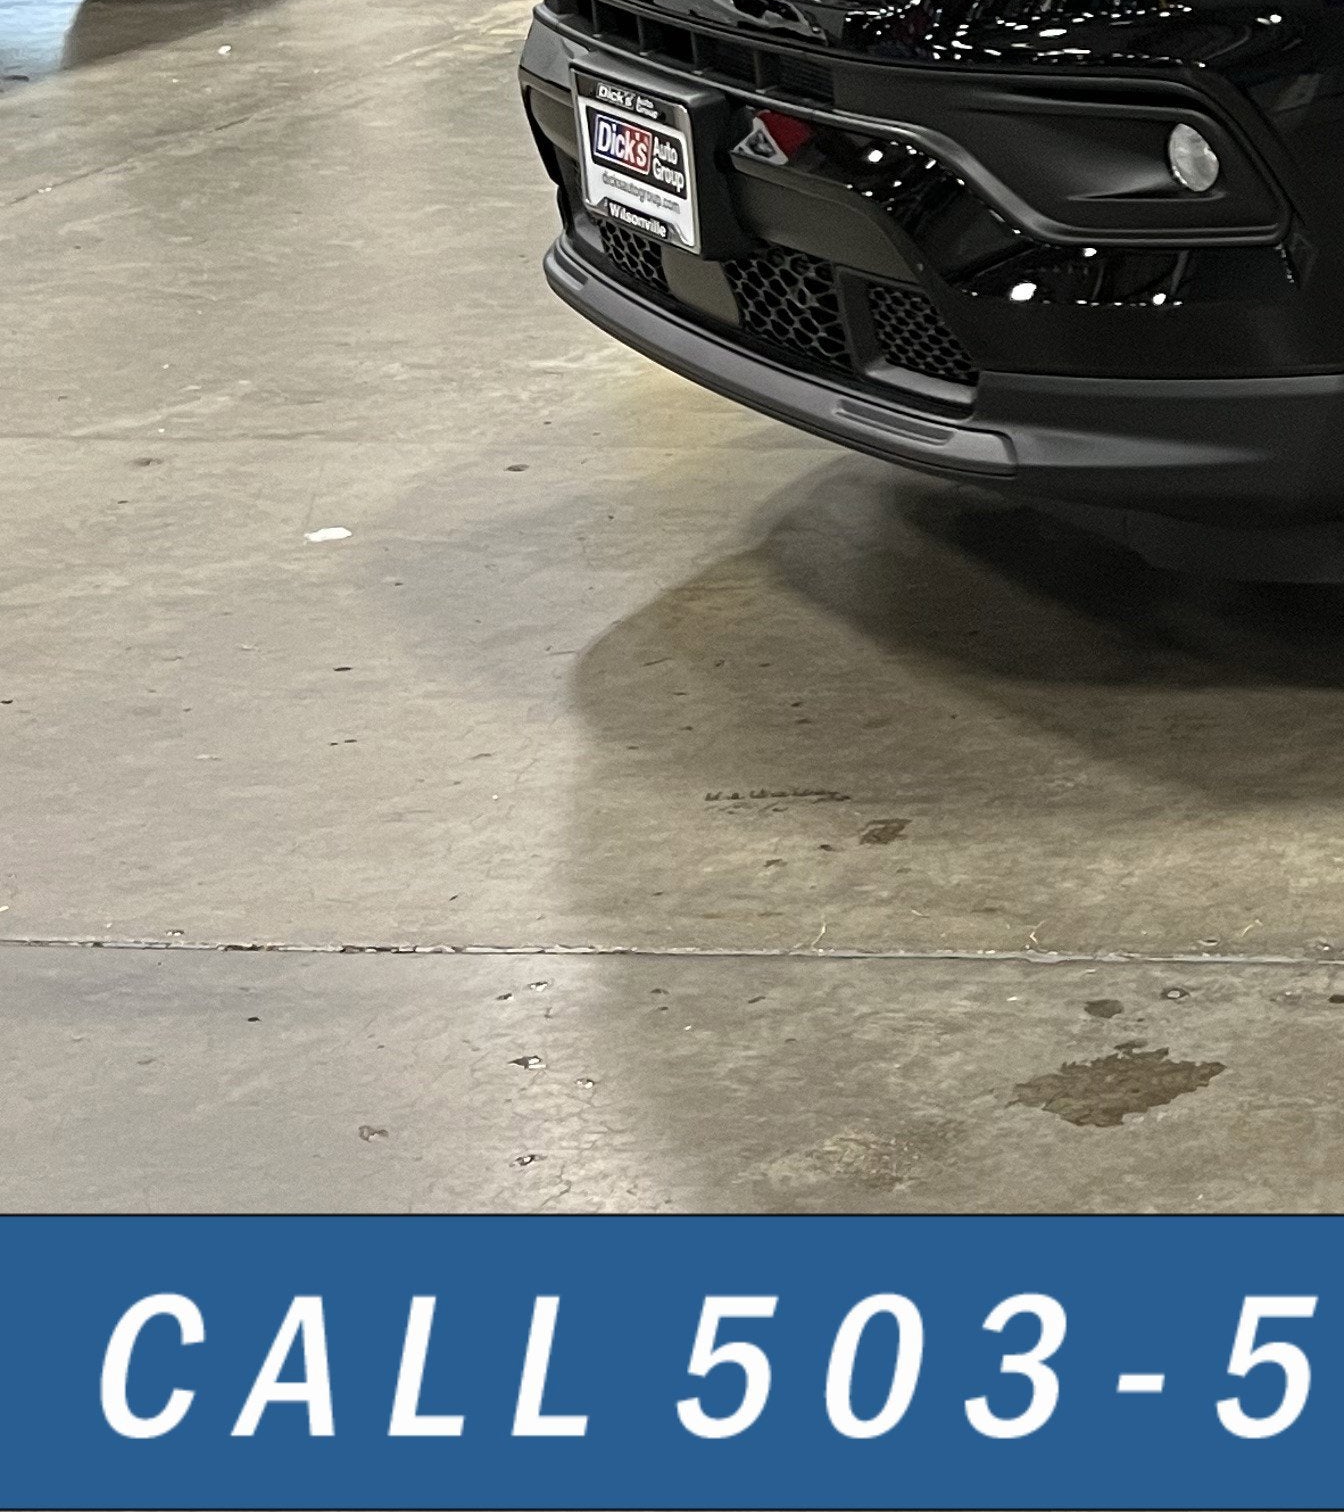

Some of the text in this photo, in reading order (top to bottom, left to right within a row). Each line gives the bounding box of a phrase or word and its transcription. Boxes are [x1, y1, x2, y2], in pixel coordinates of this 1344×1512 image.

[597, 120, 648, 168] Dick's
[653, 136, 679, 166] Auto
[652, 157, 686, 193] Group
[609, 203, 667, 239] Wilsonville
